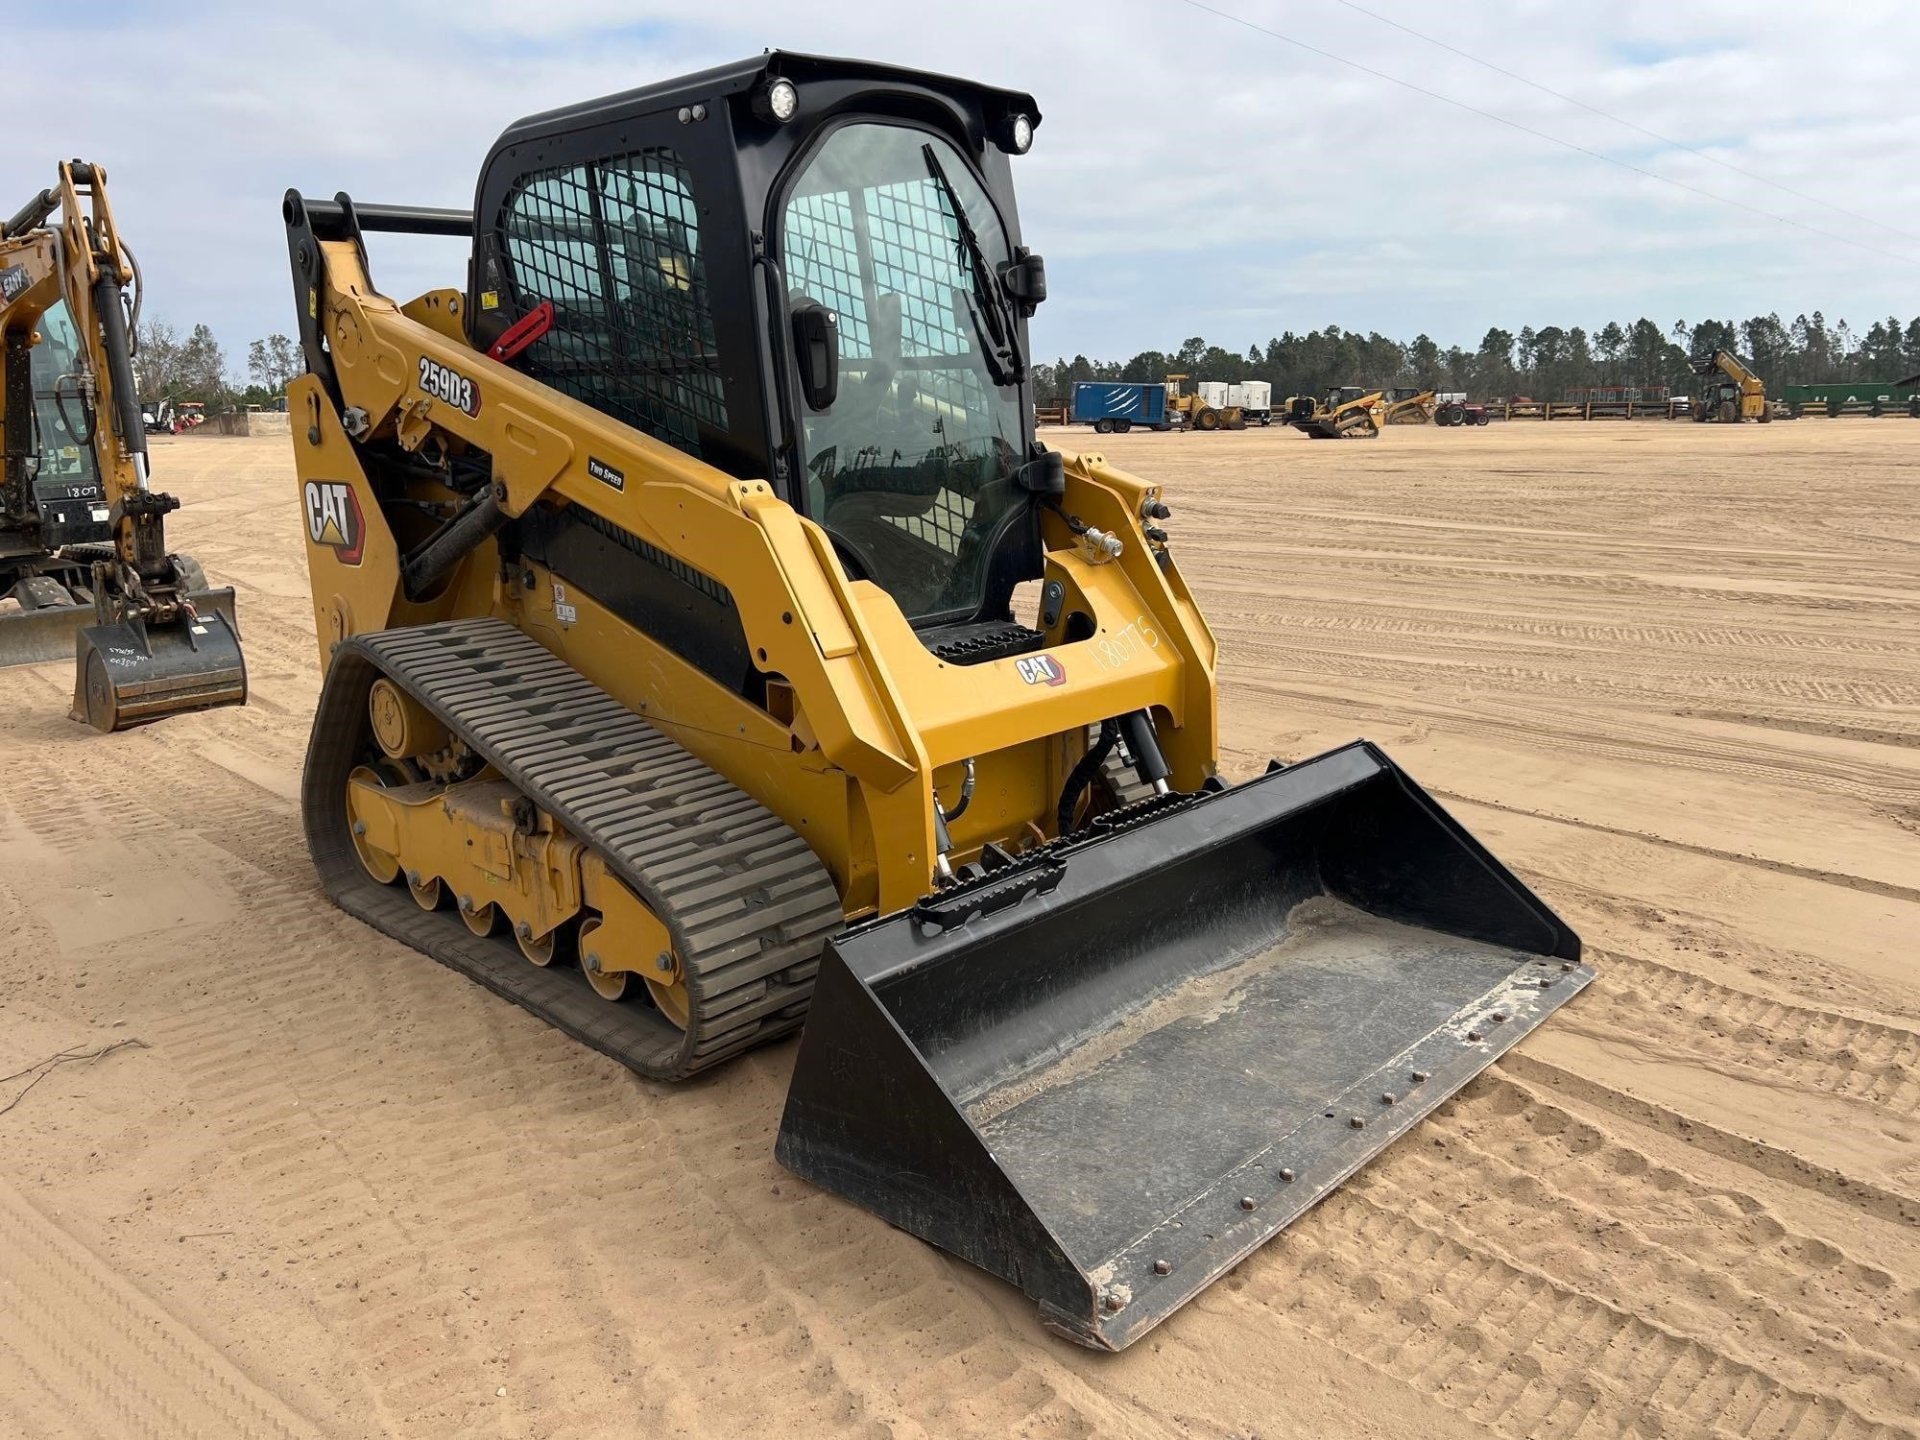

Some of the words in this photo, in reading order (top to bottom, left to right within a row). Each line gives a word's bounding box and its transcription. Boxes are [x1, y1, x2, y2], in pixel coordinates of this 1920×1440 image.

[419, 357, 472, 413] 259D3
[305, 482, 350, 545] CAT
[1016, 655, 1056, 685] CAT
